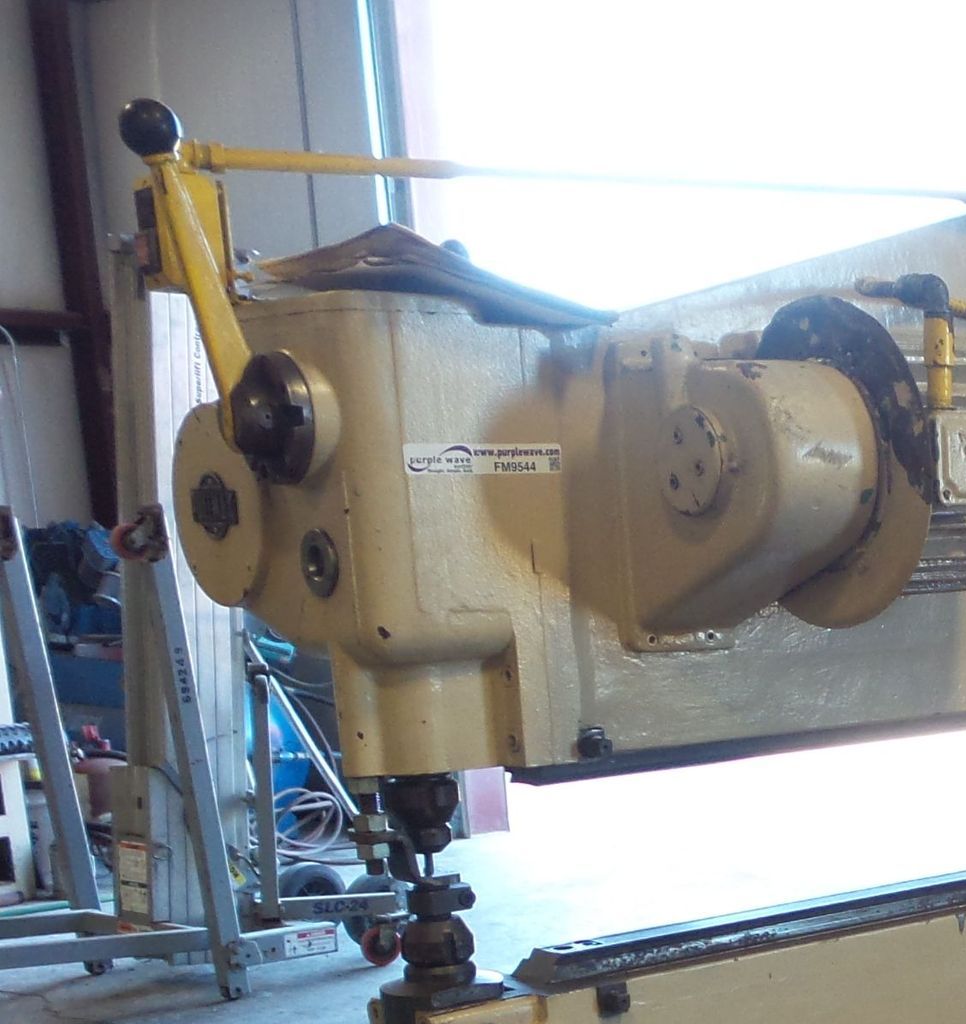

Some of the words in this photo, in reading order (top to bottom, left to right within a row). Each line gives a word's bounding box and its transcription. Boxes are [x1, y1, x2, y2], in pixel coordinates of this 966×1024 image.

[409, 455, 442, 465] purple
[445, 456, 471, 464] wave
[494, 461, 537, 473] FM9544
